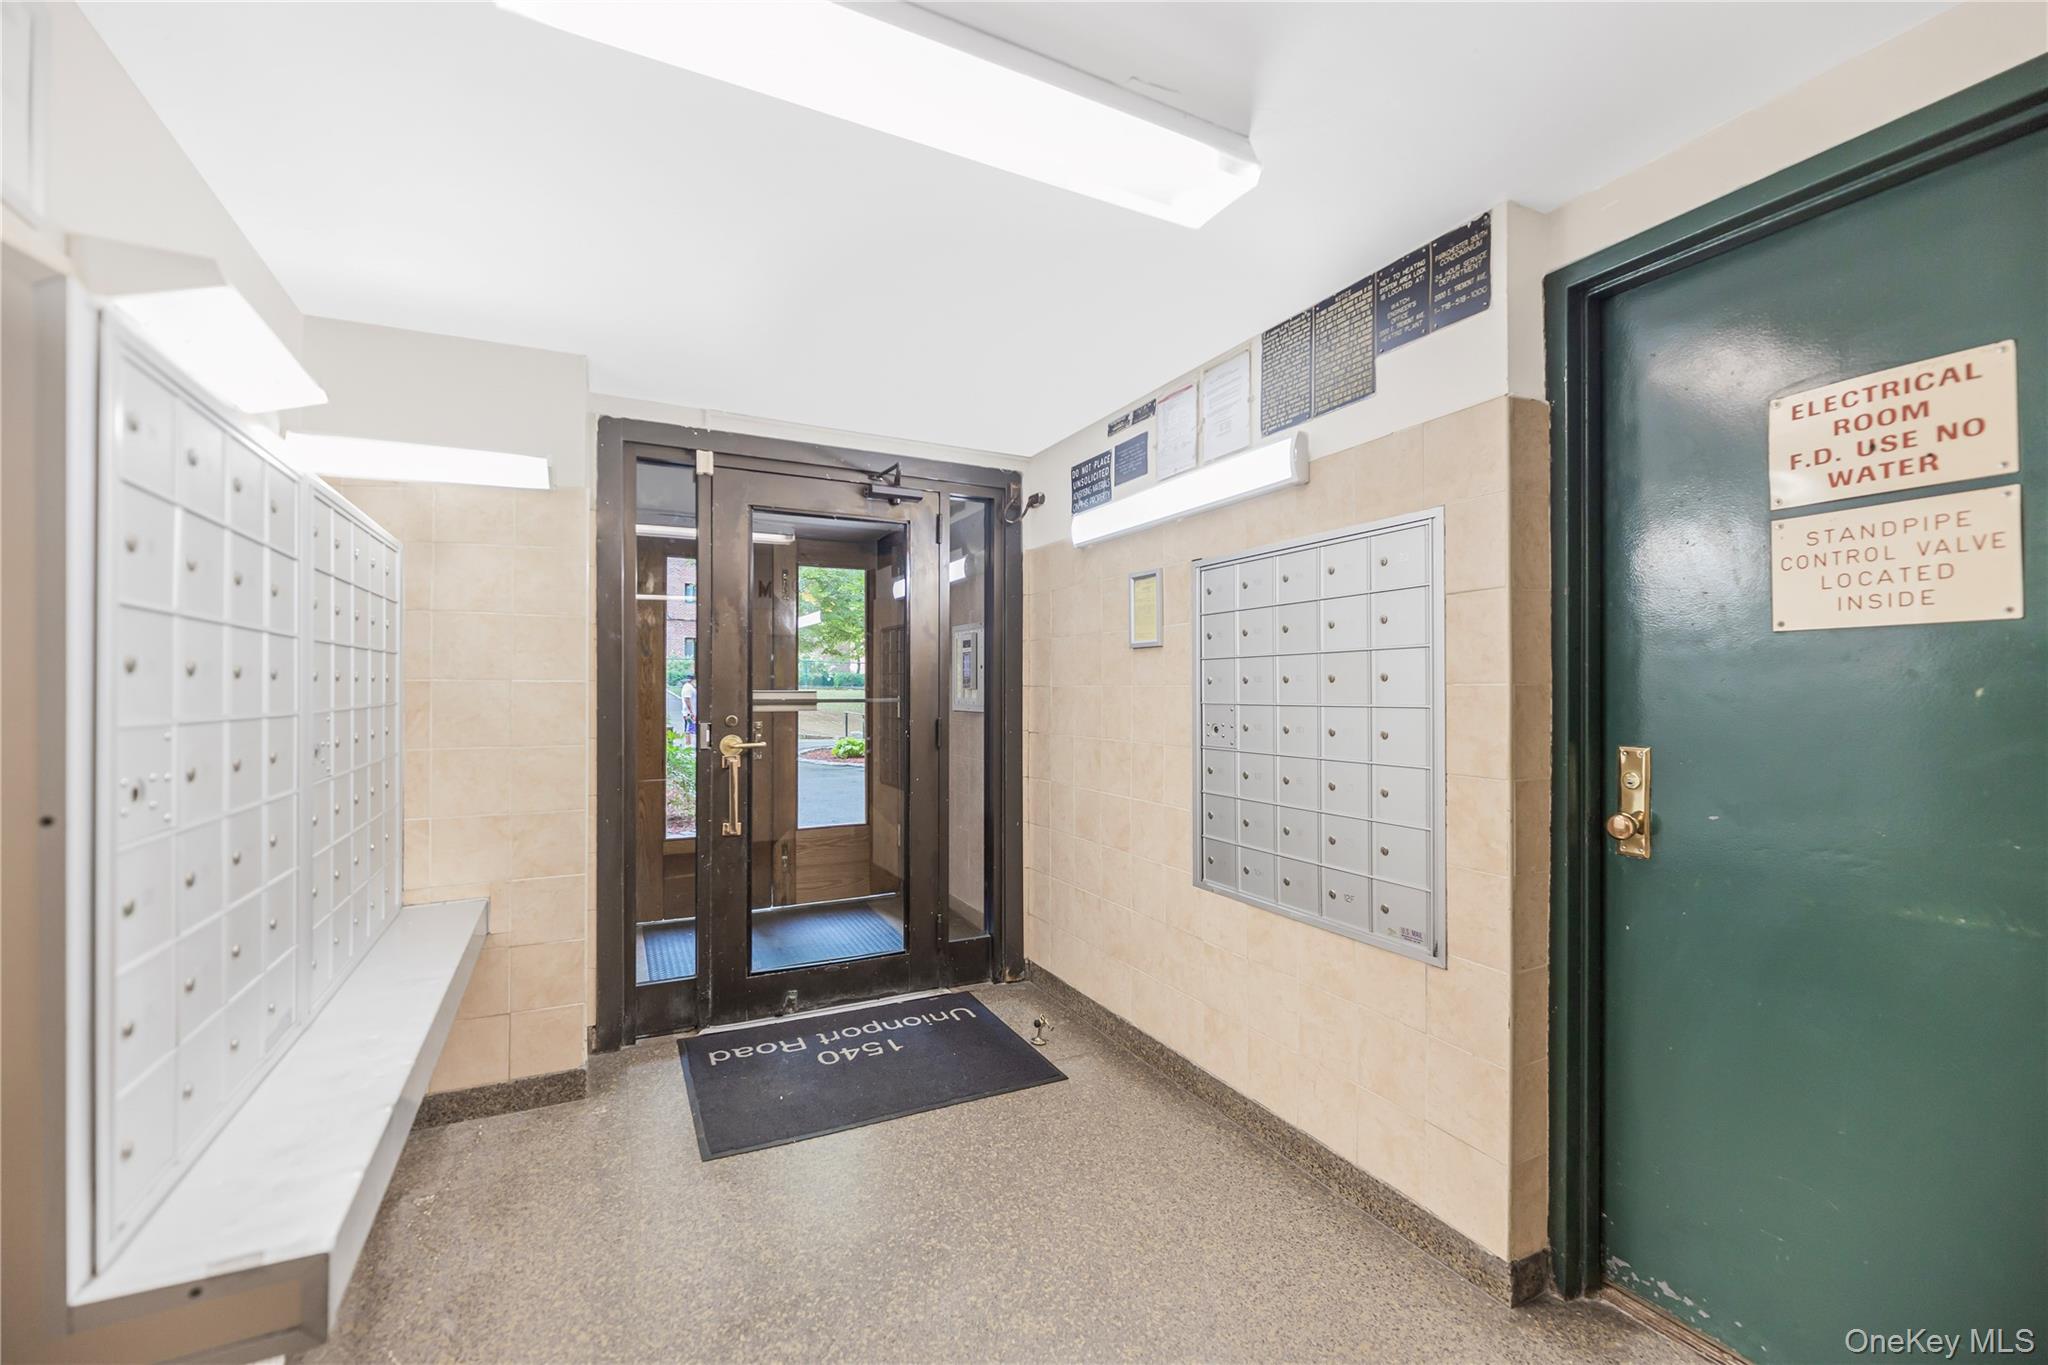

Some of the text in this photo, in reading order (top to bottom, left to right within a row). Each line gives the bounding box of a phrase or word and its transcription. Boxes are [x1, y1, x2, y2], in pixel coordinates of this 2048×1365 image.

[1439, 240, 1483, 267] CONDOMINIUM
[1445, 264, 1460, 277] HOUR
[1463, 250, 1488, 266] SERVICE
[1393, 271, 1401, 280] TO
[1403, 259, 1426, 275] HEATING
[1439, 261, 1482, 287] DEPARTMENT
[1379, 281, 1398, 295] SYSTEM
[1400, 275, 1412, 284] AREA
[1388, 282, 1413, 298] LOCATED
[1391, 312, 1408, 325] OFFICE
[1404, 320, 1423, 332] PLANT
[1791, 362, 1983, 421] ELECTRICAL
[1833, 400, 1930, 436] ROOM
[1790, 417, 1986, 471] F.D. USE NO
[1072, 454, 1111, 479] DO NOT PLACE
[1073, 466, 1110, 490] UNSOLICITED
[1827, 454, 1939, 488] WATER
[1807, 510, 1972, 546] STANDPIPE
[1781, 531, 2007, 572] CONTROL VALVE
[1821, 562, 1955, 590] LOCATED
[1837, 589, 1936, 611] INSIDE
[708, 1006, 977, 1067] Unionport Road
[816, 1038, 905, 1066] 1540
